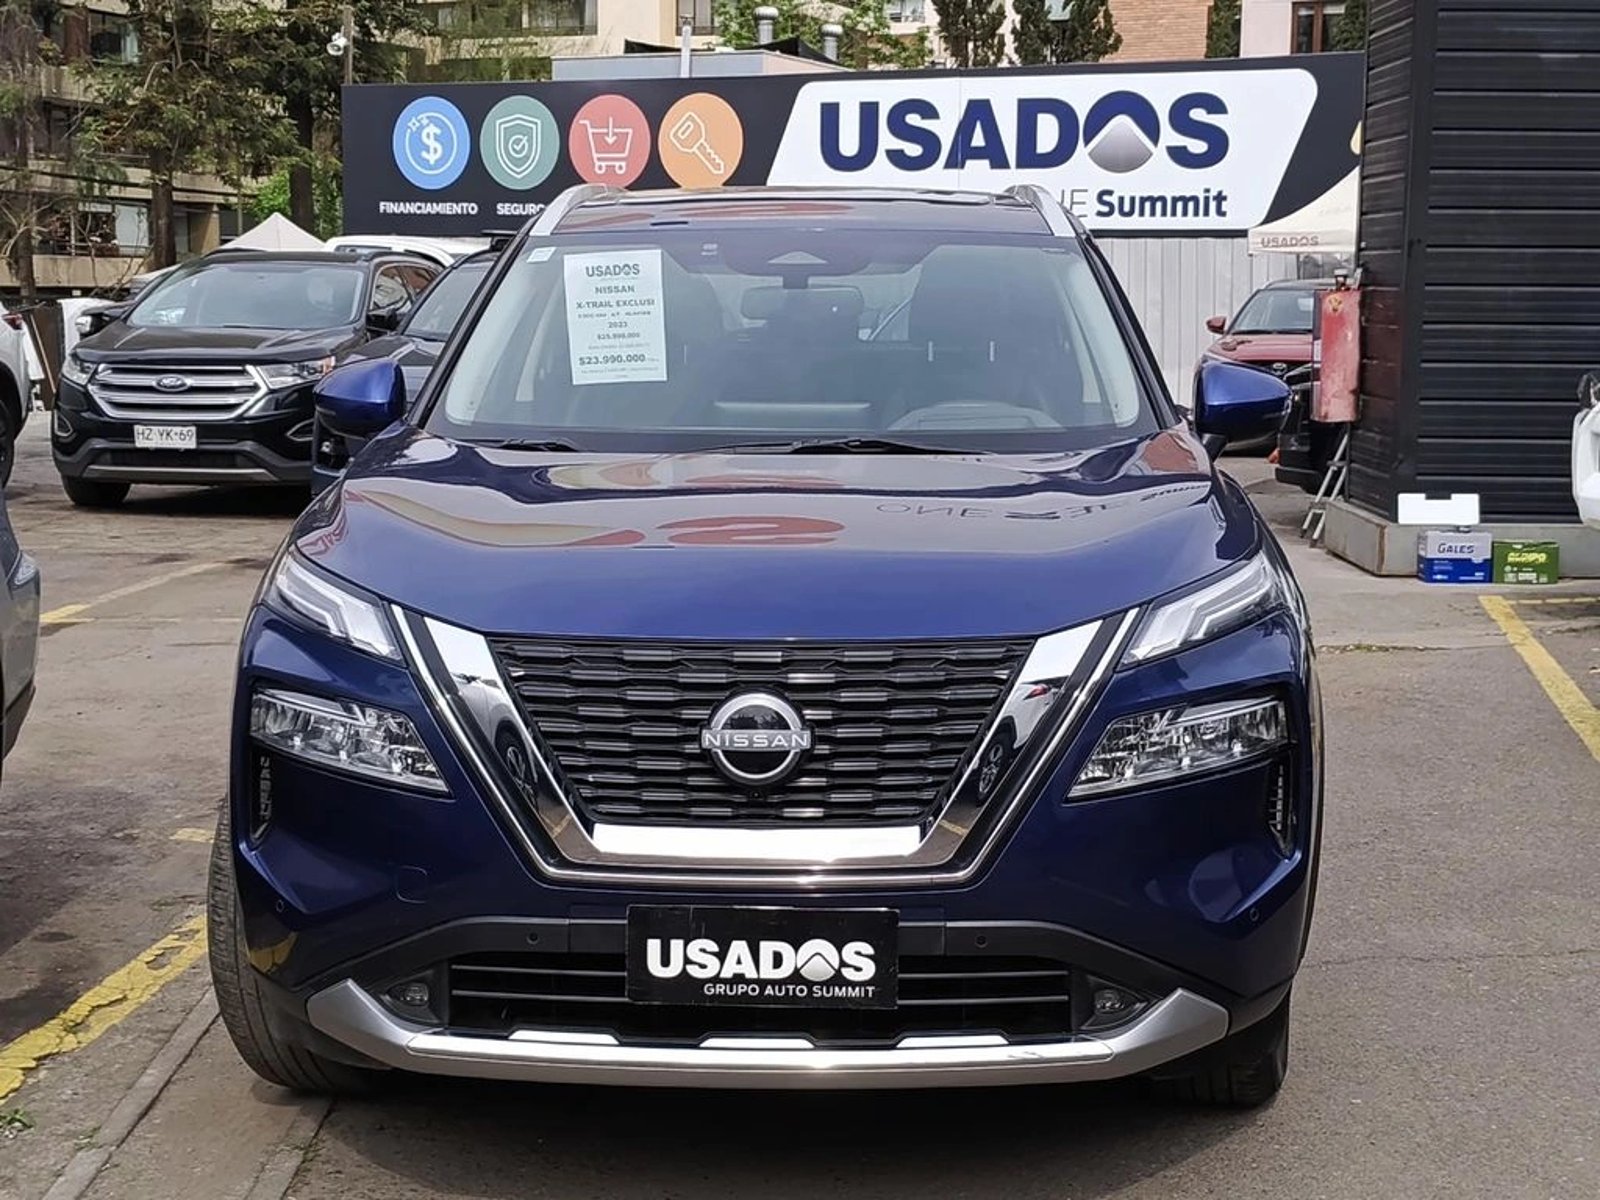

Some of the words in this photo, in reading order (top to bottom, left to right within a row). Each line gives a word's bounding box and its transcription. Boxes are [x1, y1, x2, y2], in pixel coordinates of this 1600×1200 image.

[820, 90, 1230, 174] USADOS
[379, 201, 479, 215] FINANCIAMIENTO
[1096, 188, 1228, 218] Summit
[1260, 235, 1320, 248] USADOS
[585, 263, 641, 277] USADOS
[594, 285, 636, 295] NISSAN
[576, 301, 613, 309] X-TRAIL
[1437, 542, 1476, 555] GALES
[704, 733, 808, 748] NISSAN
[646, 938, 877, 982] USADOS
[703, 983, 760, 997] GRUPO
[763, 984, 808, 998] AUTO
[812, 985, 876, 999] SUMMIT
